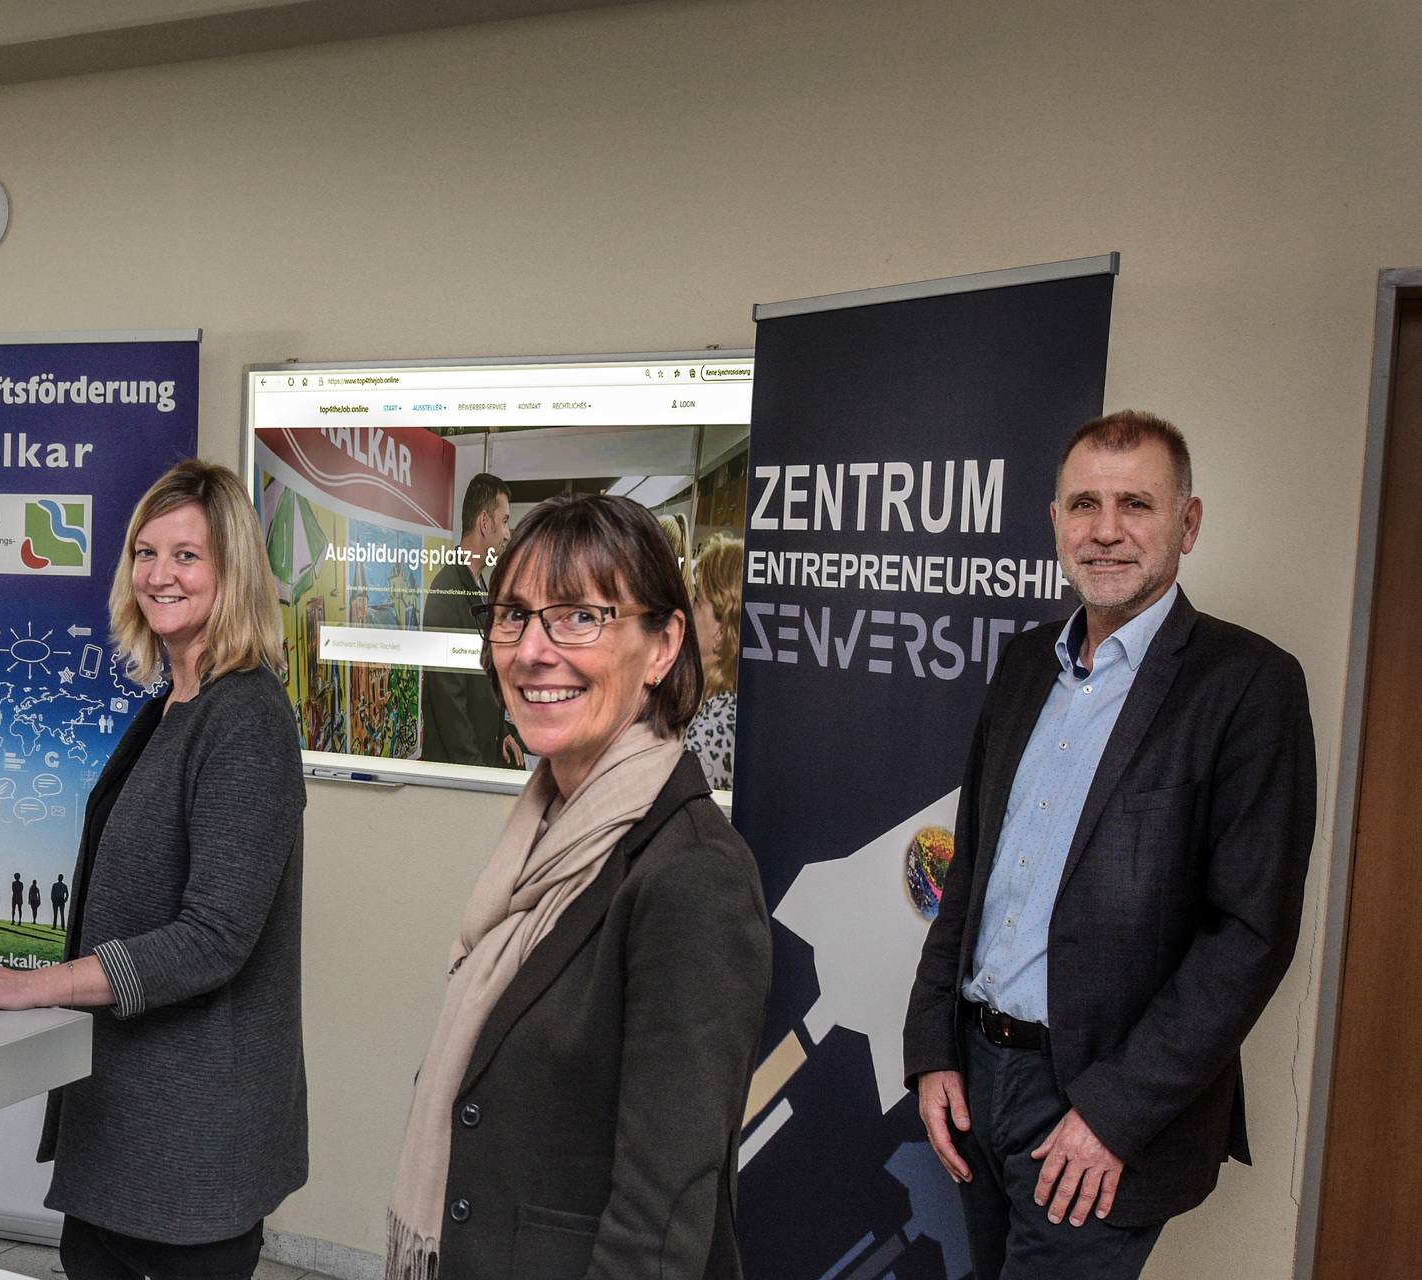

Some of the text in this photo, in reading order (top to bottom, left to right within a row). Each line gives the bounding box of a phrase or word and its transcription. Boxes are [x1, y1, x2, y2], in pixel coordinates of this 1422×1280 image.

[518, 402, 541, 410] KONTAKT
[552, 402, 587, 410] RECHTLICHES
[679, 400, 696, 409] LOGIN
[321, 427, 412, 487] ALKAR
[750, 458, 1005, 534] ZENTRUM
[324, 542, 499, 570] Ausbildungsplatz- &
[452, 647, 468, 655] Suche
